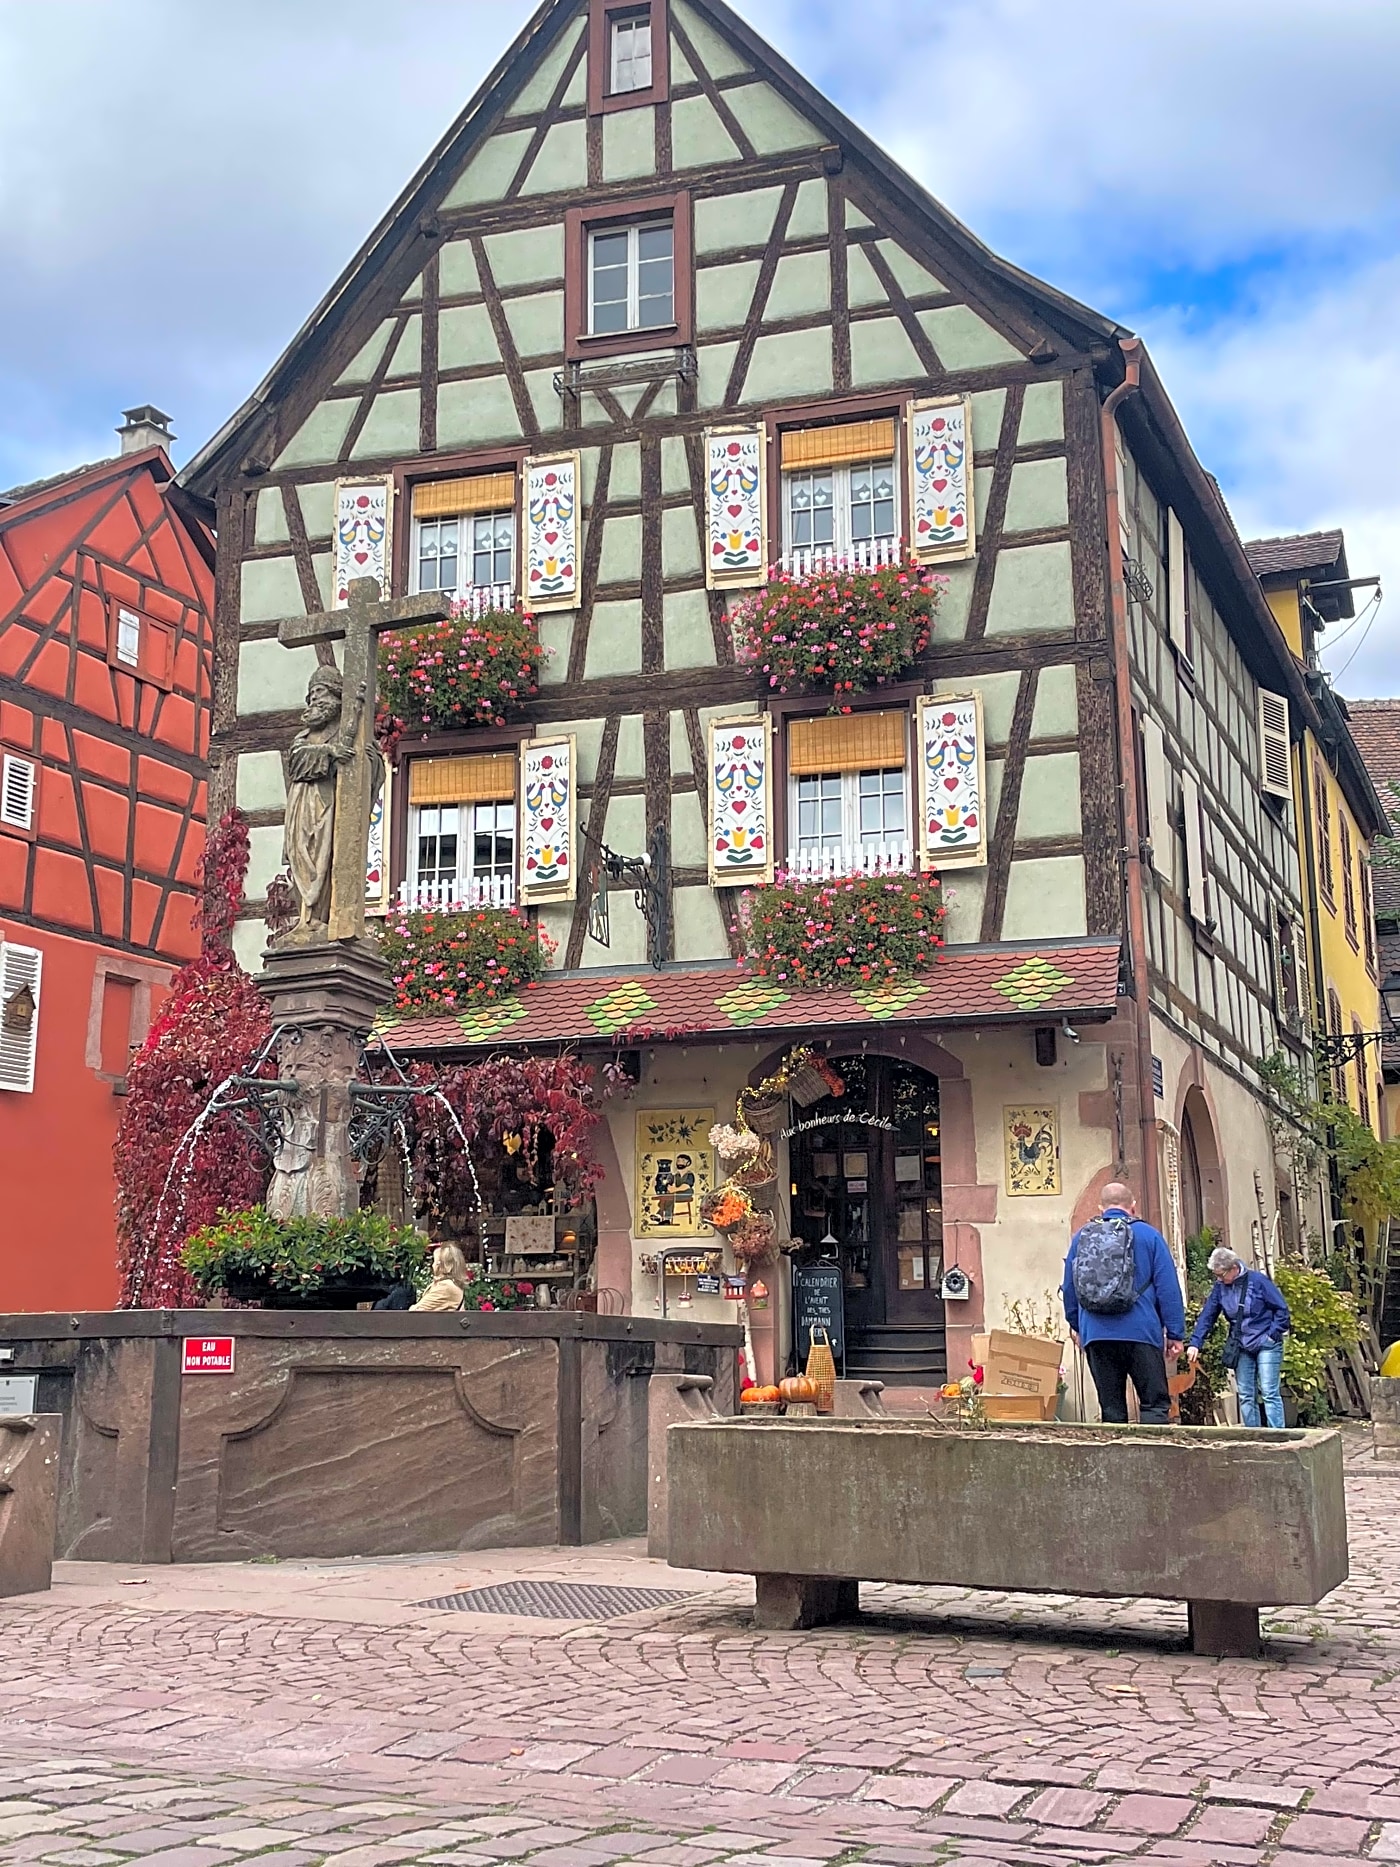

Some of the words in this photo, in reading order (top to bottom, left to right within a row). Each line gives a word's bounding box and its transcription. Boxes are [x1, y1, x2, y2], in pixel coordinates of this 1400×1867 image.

[780, 1126, 796, 1140] Aux
[798, 1111, 840, 1132] bonheurs
[843, 1108, 855, 1123] de
[859, 1111, 892, 1131] Cécile
[800, 1277, 838, 1288] CALENDRIER
[202, 1341, 216, 1352] EAU
[186, 1355, 201, 1366] NON
[202, 1355, 230, 1366] POTABLE
